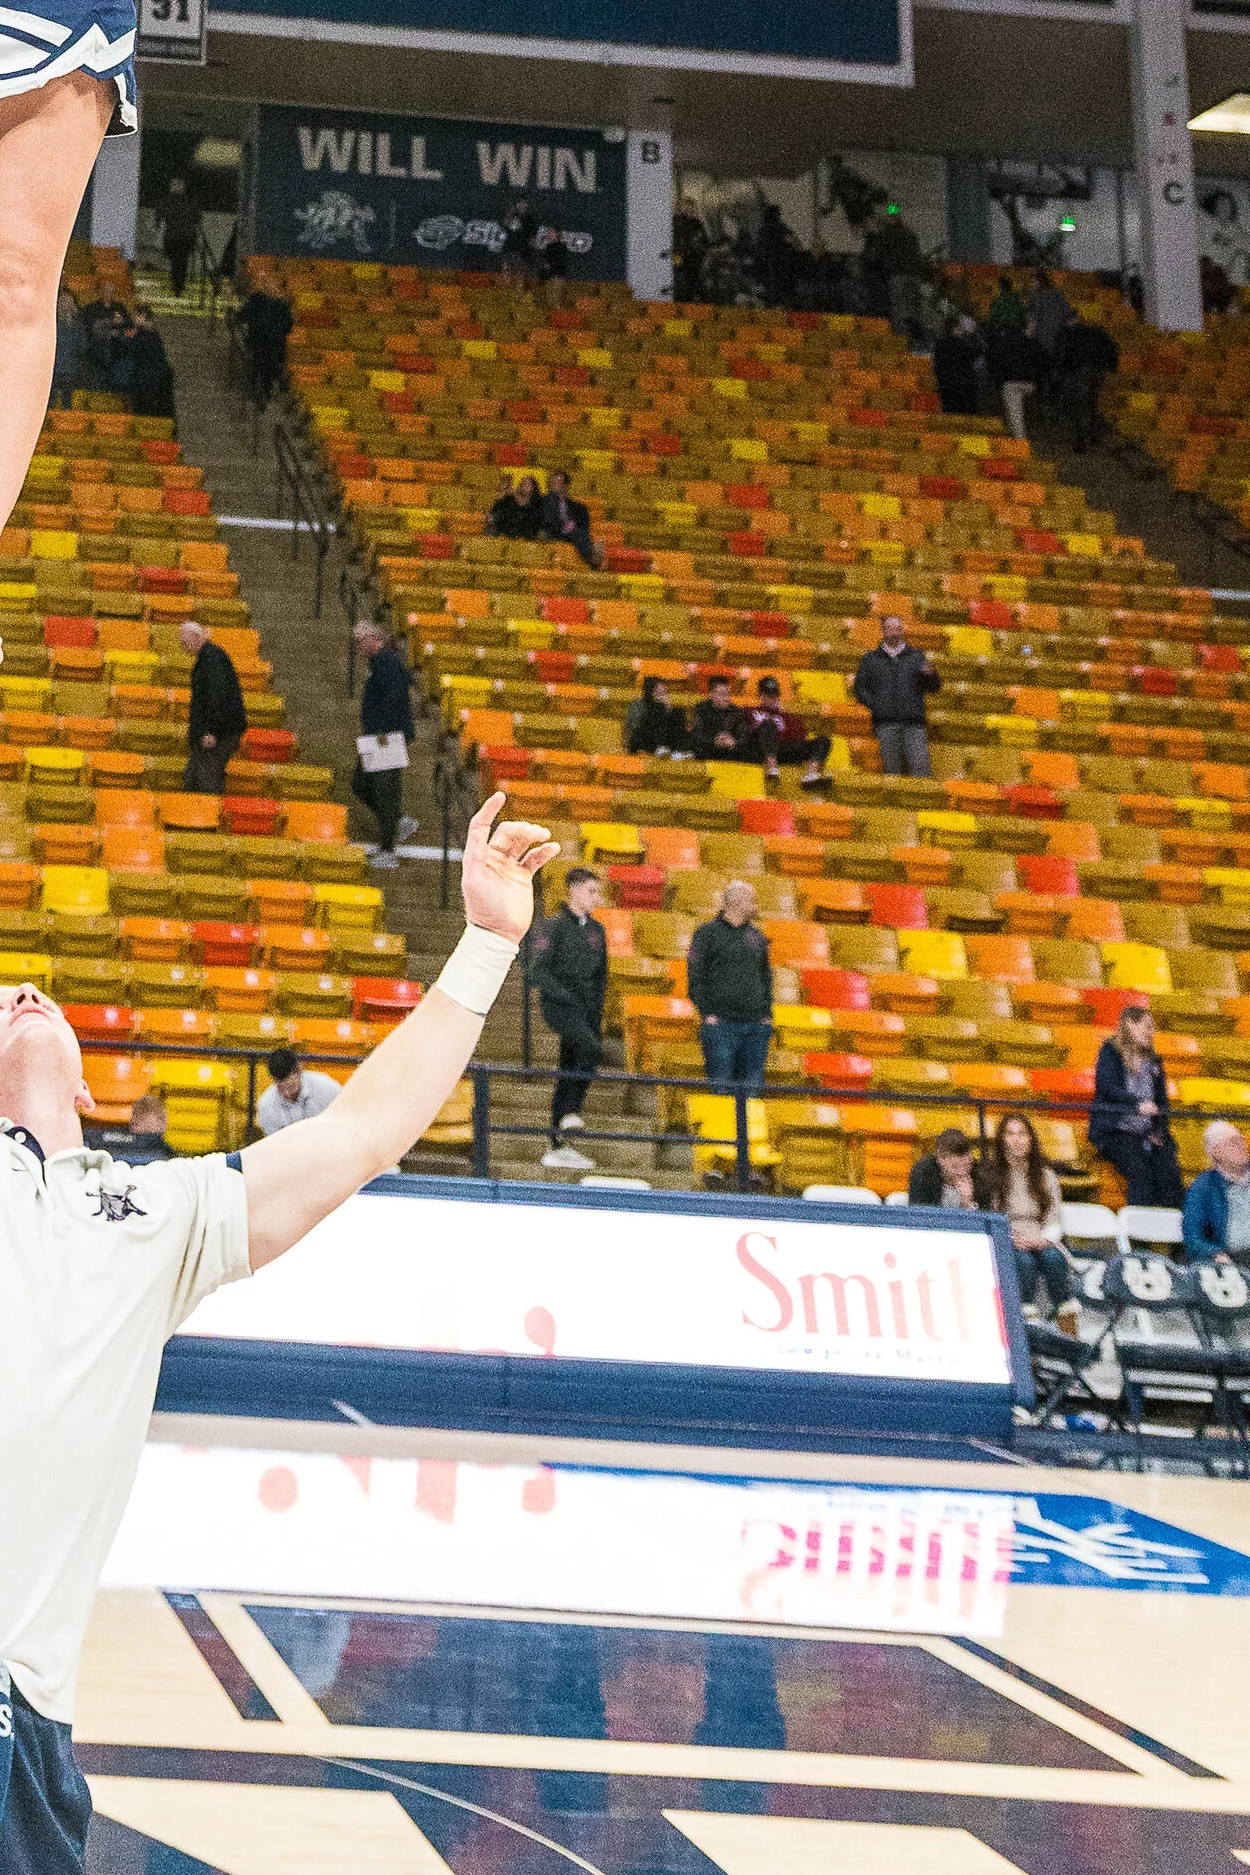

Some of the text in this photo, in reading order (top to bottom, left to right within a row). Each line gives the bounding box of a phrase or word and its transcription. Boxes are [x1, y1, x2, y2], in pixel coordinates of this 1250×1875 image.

[298, 126, 598, 194] WILL WIN
[1163, 180, 1185, 206] C
